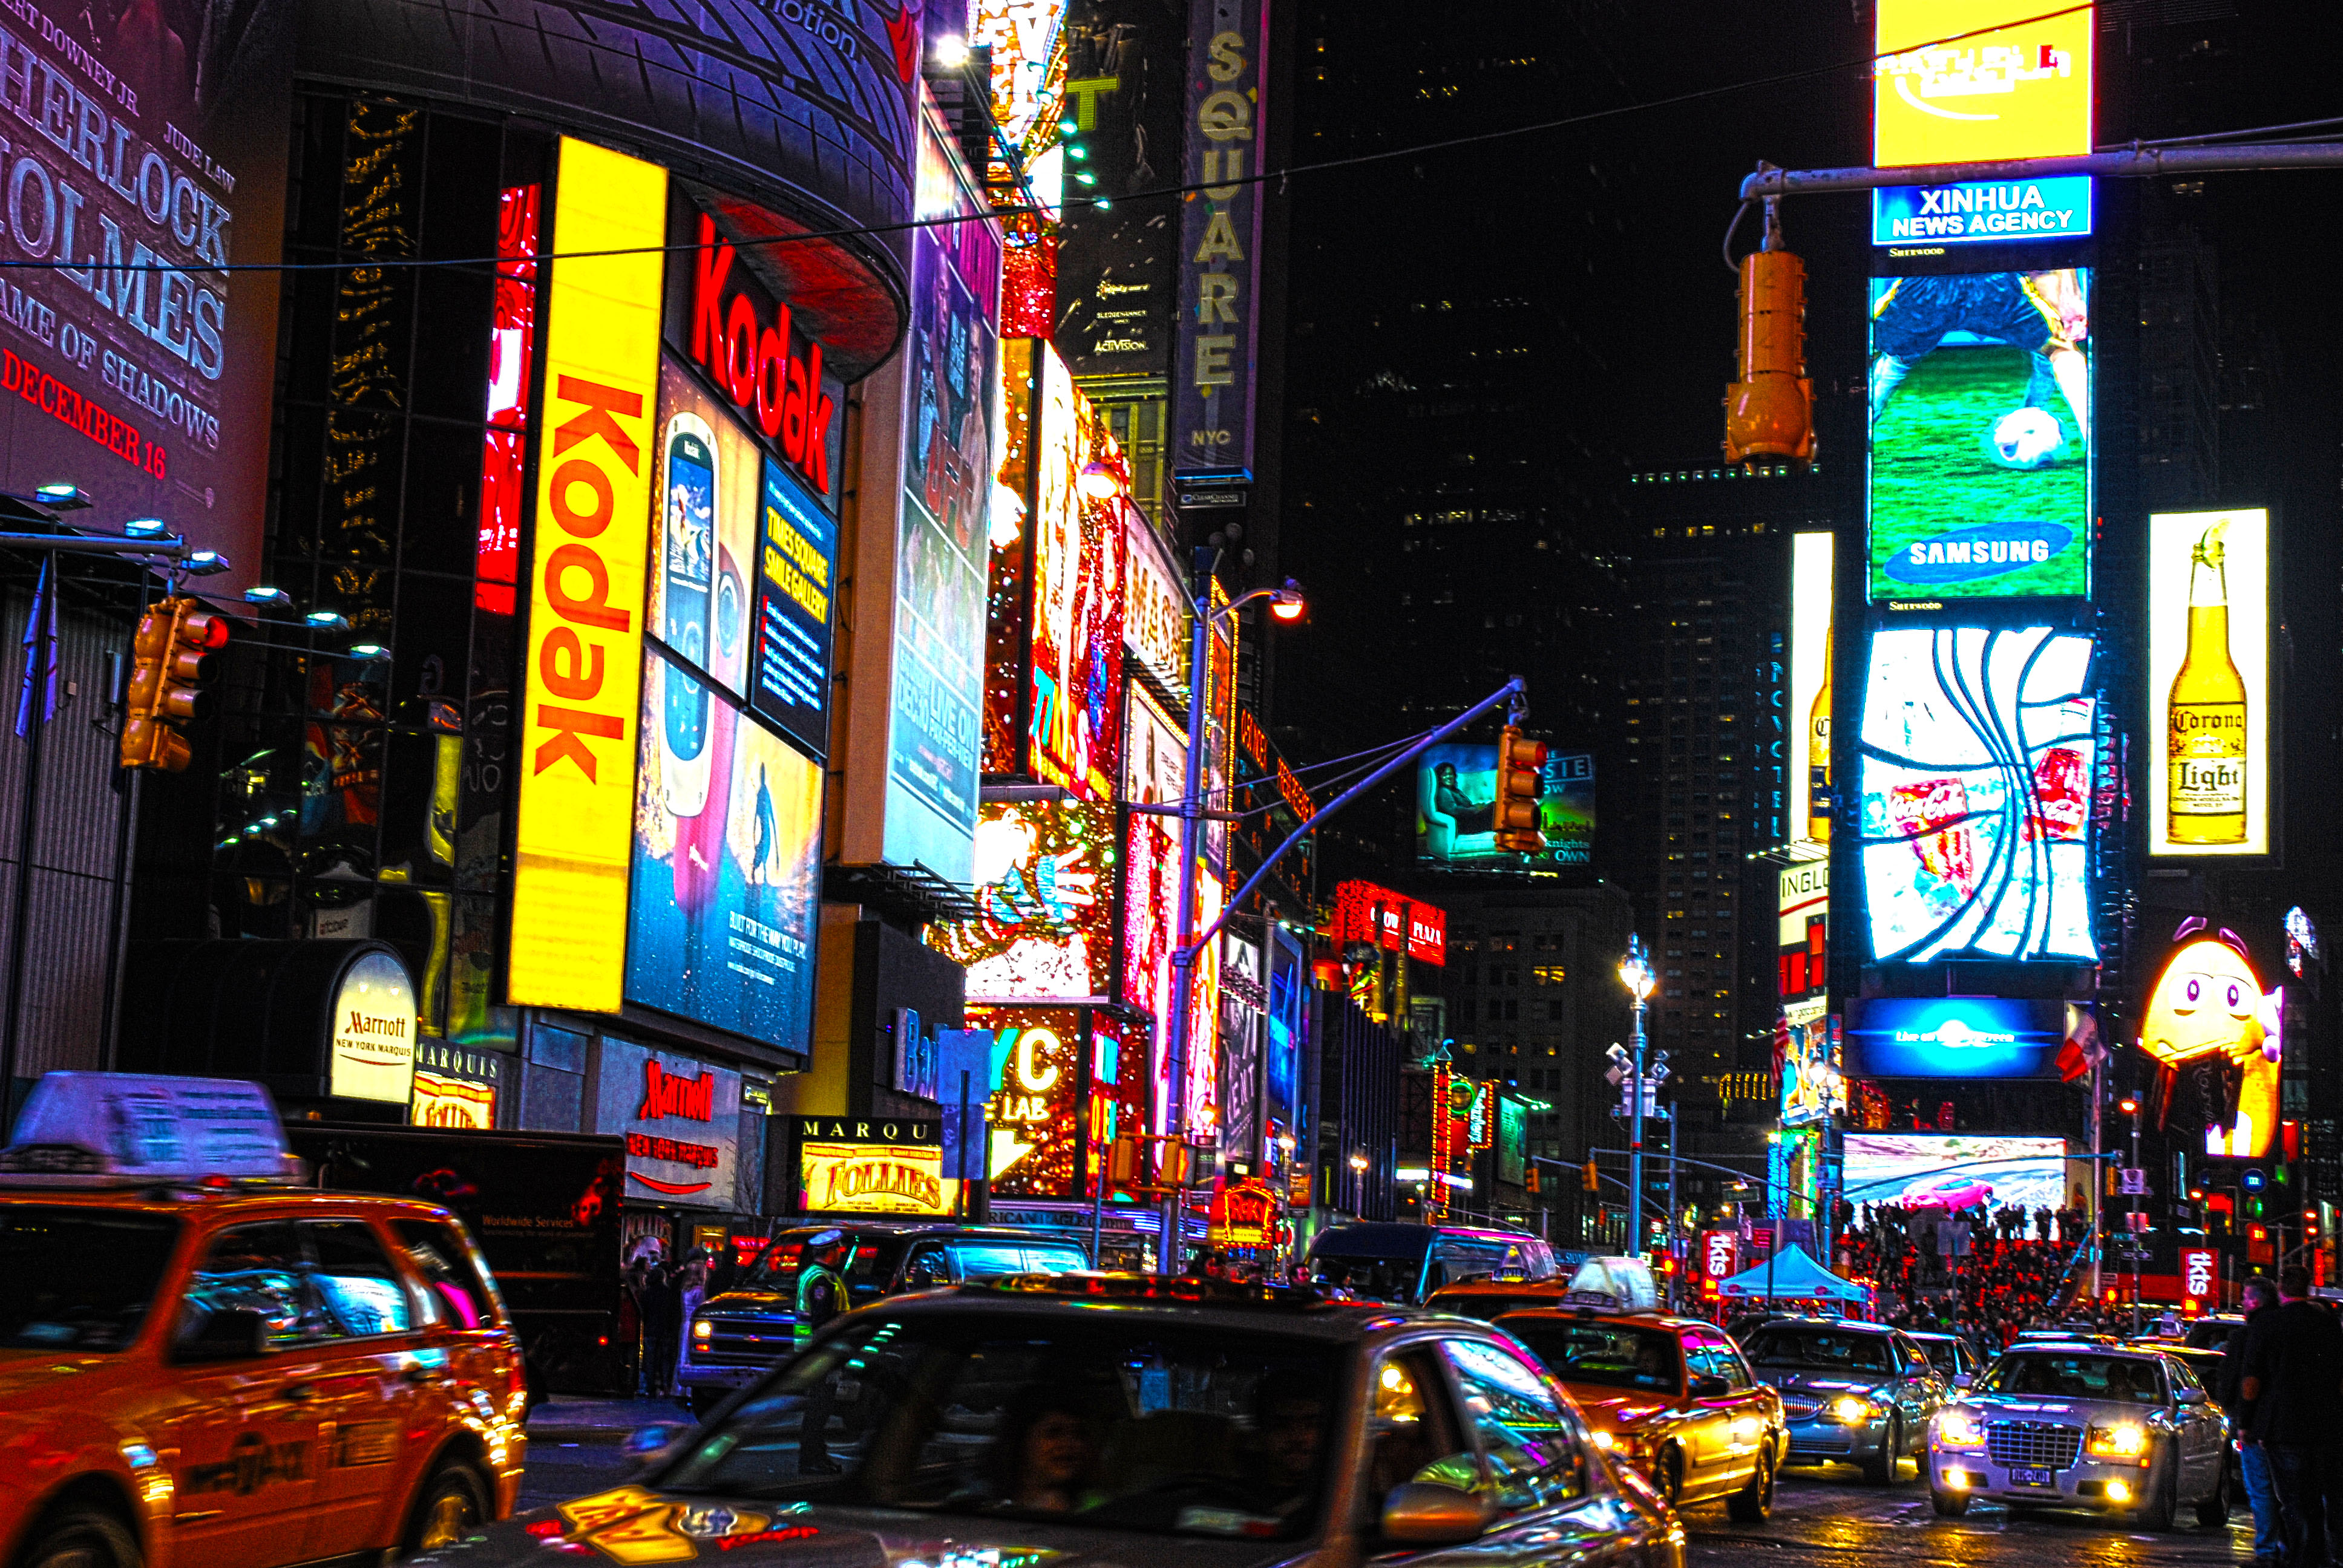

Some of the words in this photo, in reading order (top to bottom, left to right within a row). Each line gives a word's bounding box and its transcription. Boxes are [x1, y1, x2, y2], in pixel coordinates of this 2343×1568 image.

[0, 0, 39, 29] RT
[41, 14, 116, 96] DOWNEY
[165, 121, 204, 169] JUDE
[204, 154, 236, 194] LAW
[1194, 31, 1253, 387] SQUARE
[1920, 185, 2045, 215] XINHUA
[1892, 214, 1964, 237] NEWS
[1969, 210, 2074, 234] AGENCY
[0, 134, 224, 380] OLMES
[694, 213, 833, 495] Kodak
[1093, 339, 1147, 353] ACTIVISION
[61, 322, 97, 370] OF
[102, 348, 220, 451] SHADOWS
[1, 348, 141, 467] DECEMBER
[143, 440, 166, 480] 16
[1191, 429, 1231, 446] NYC
[794, 534, 828, 587] SQUARE
[1910, 539, 2049, 565] SAMSUNG
[534, 374, 643, 786] Kodak
[764, 546, 793, 593] SMILE
[792, 572, 828, 624] GALLERY
[2174, 710, 2243, 733] Corona
[1545, 759, 1585, 779] SIE
[2178, 762, 2238, 791] Light
[1544, 785, 1565, 794] OW
[1545, 838, 1590, 849] knights
[1555, 849, 1590, 863] OWN
[345, 1011, 406, 1037] Marriott
[336, 1038, 355, 1048] NEW
[356, 1040, 376, 1052] YORK
[378, 1042, 411, 1057] MARQUIS
[416, 1043, 497, 1079] MARQUIS
[1002, 1096, 1051, 1121] LAB
[802, 1121, 928, 1140] MARQU
[1437, 1074, 1449, 1202] HERSHES
[824, 1160, 940, 1209] FOLLIES
[482, 1214, 532, 1227] Worldwide
[536, 1215, 574, 1228] Services
[1709, 1234, 1732, 1276] tkts
[2188, 1251, 2212, 1296] tkts
